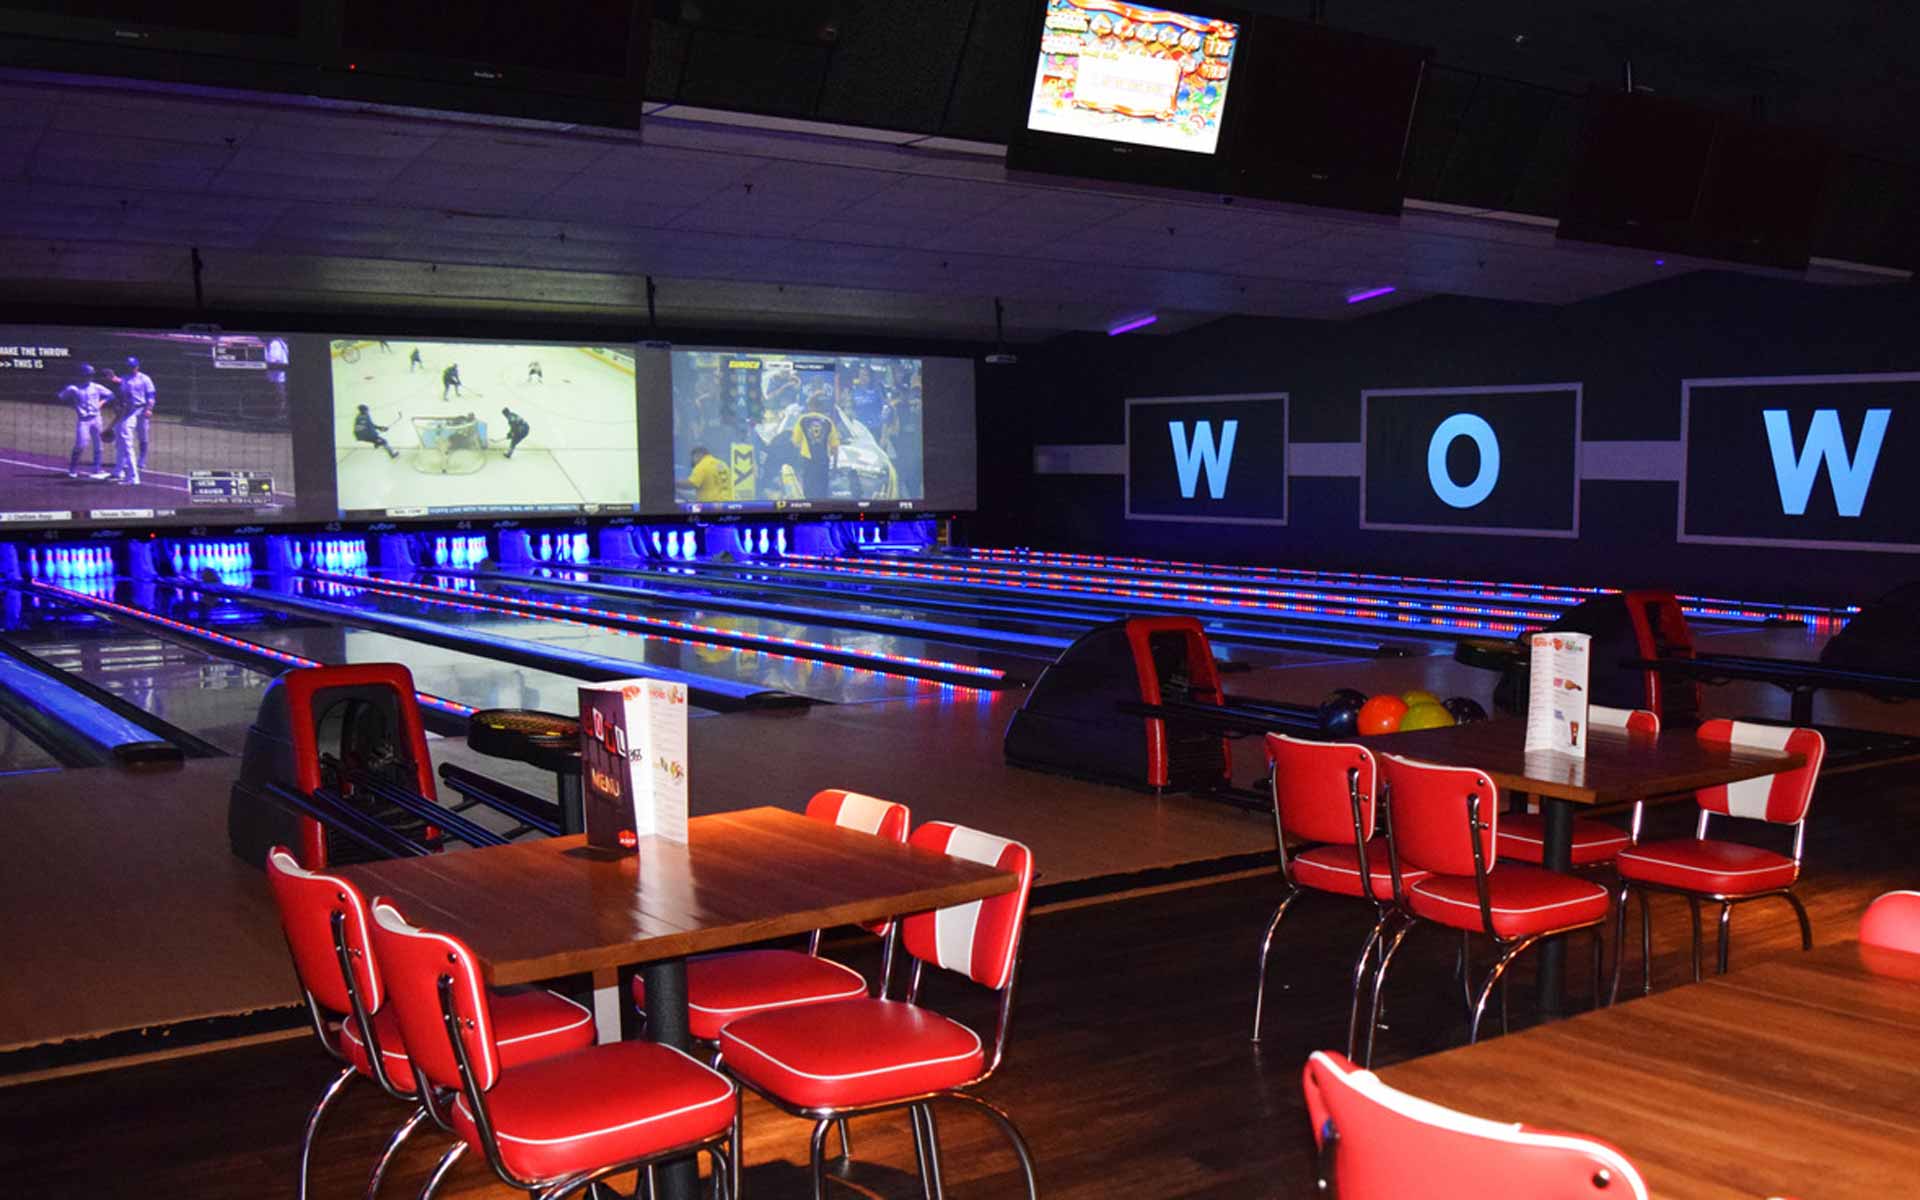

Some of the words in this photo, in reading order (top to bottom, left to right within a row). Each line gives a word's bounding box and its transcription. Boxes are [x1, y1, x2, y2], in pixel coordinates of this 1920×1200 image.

[20, 346, 37, 357] THE
[14, 359, 32, 368] THIS
[33, 359, 44, 368] IS
[1168, 420, 1238, 499] W
[1427, 412, 1500, 508] O
[1762, 409, 1892, 518] W
[592, 768, 620, 797] MENU
